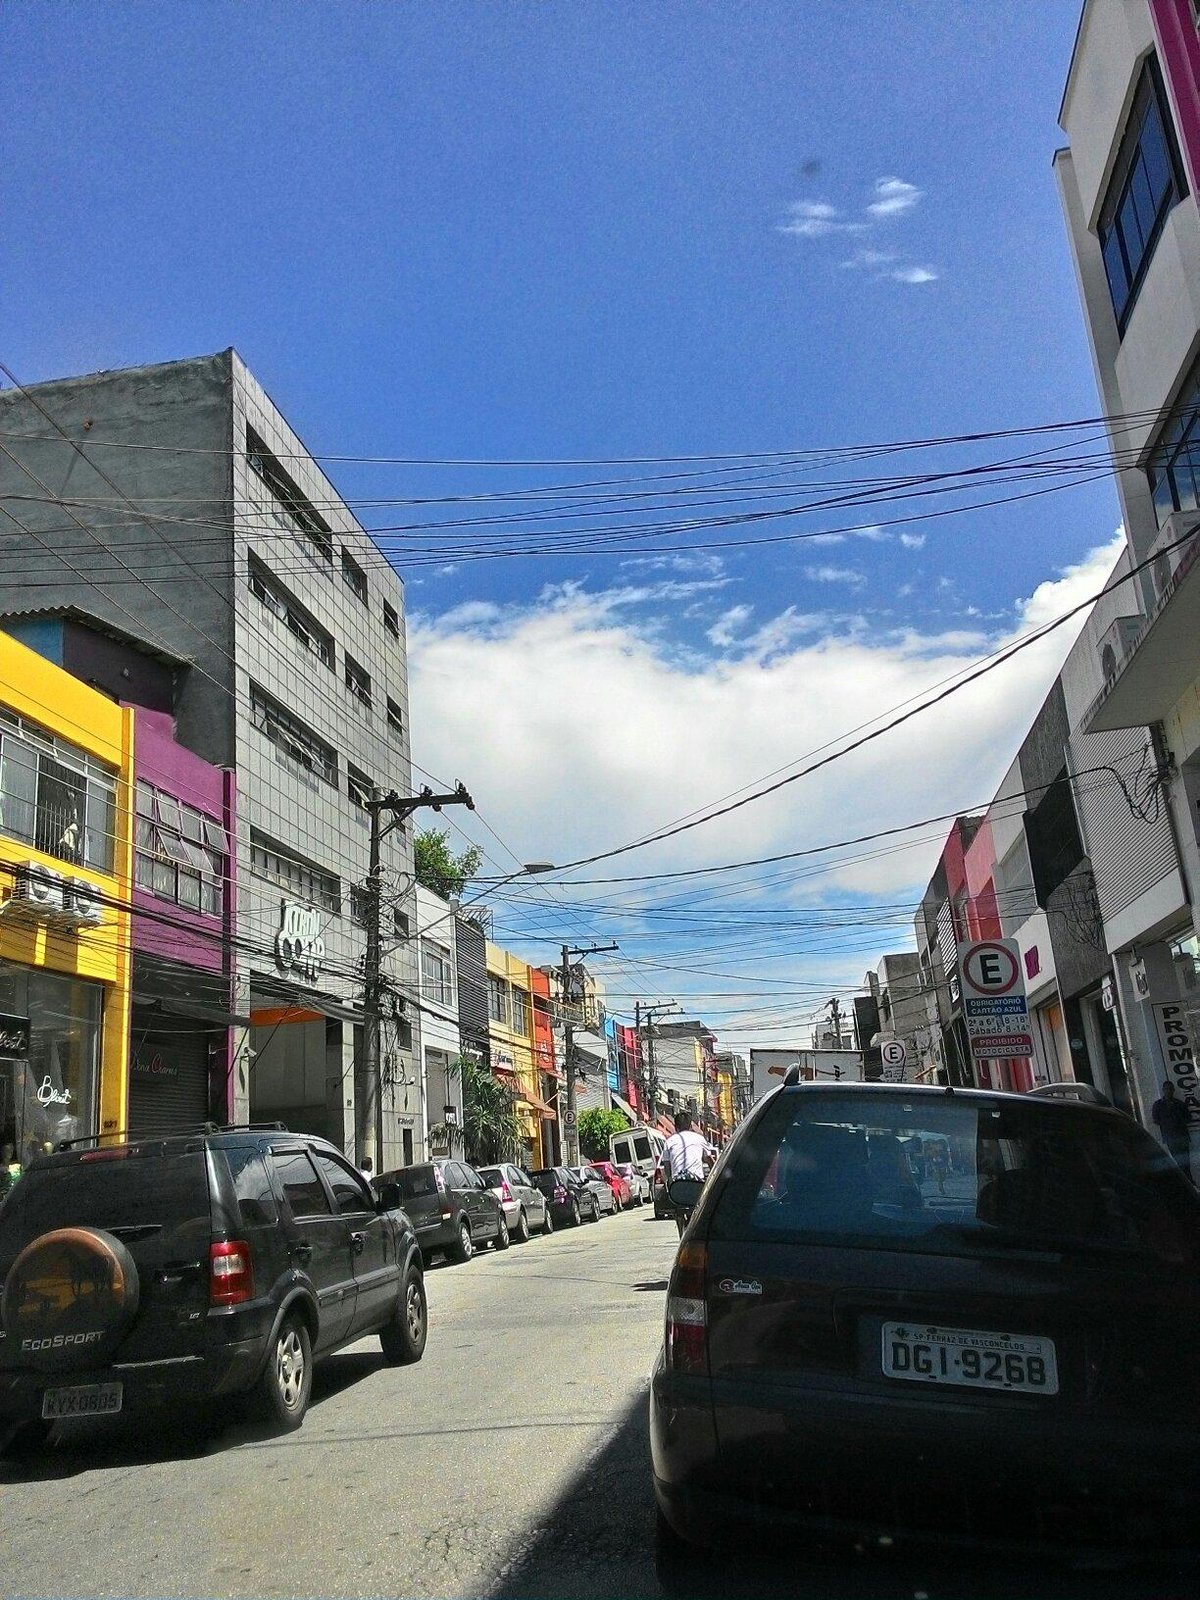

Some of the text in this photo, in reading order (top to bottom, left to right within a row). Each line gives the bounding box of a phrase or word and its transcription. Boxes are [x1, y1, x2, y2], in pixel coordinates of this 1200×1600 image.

[979, 953, 1002, 985] E
[1004, 1005, 1024, 1013] AZUL
[979, 1037, 1024, 1047] PROIBIDO
[889, 1046, 898, 1060] E
[971, 1338, 1025, 1350] VASCONCELOS
